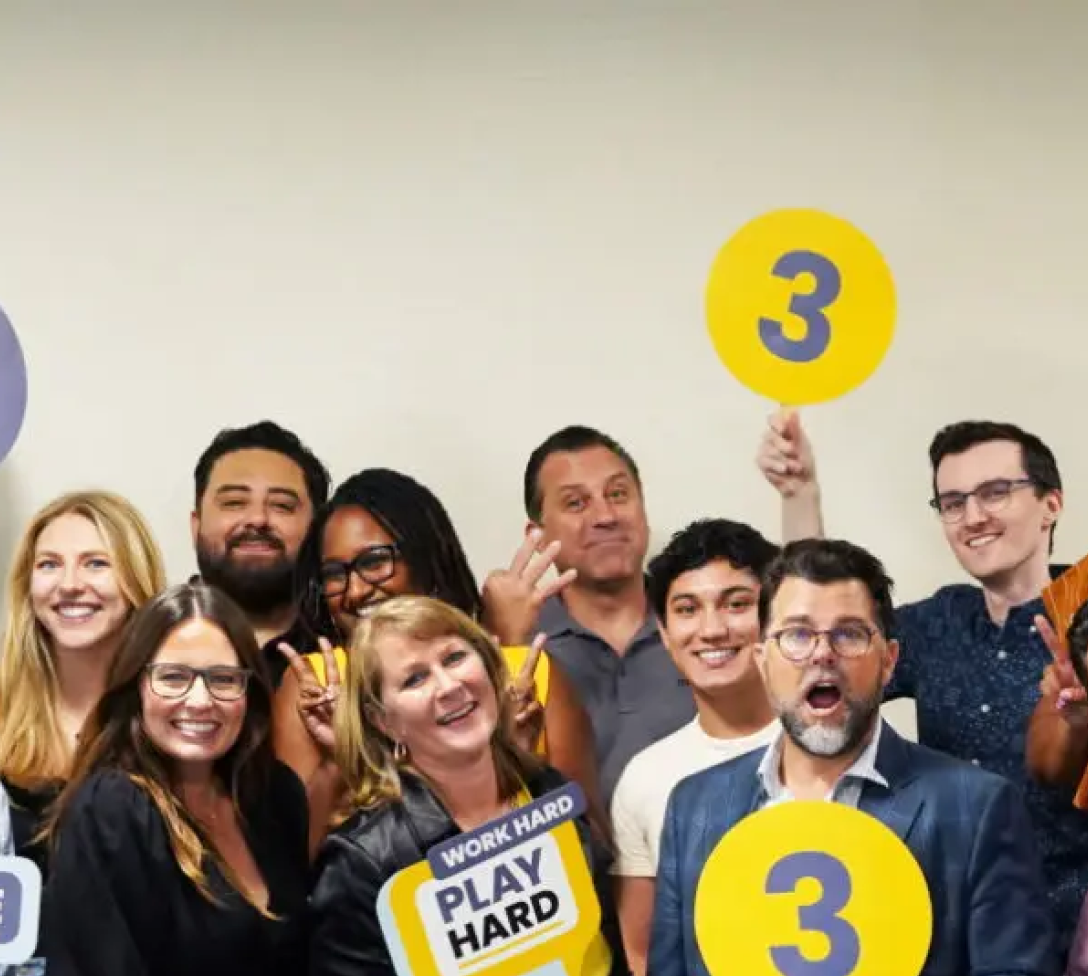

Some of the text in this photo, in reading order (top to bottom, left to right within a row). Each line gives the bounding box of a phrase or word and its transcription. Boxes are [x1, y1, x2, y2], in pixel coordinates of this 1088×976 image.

[758, 250, 840, 362] 3
[441, 794, 574, 868] WORK HARD
[434, 847, 542, 924] PLAY
[447, 890, 560, 959] HARD
